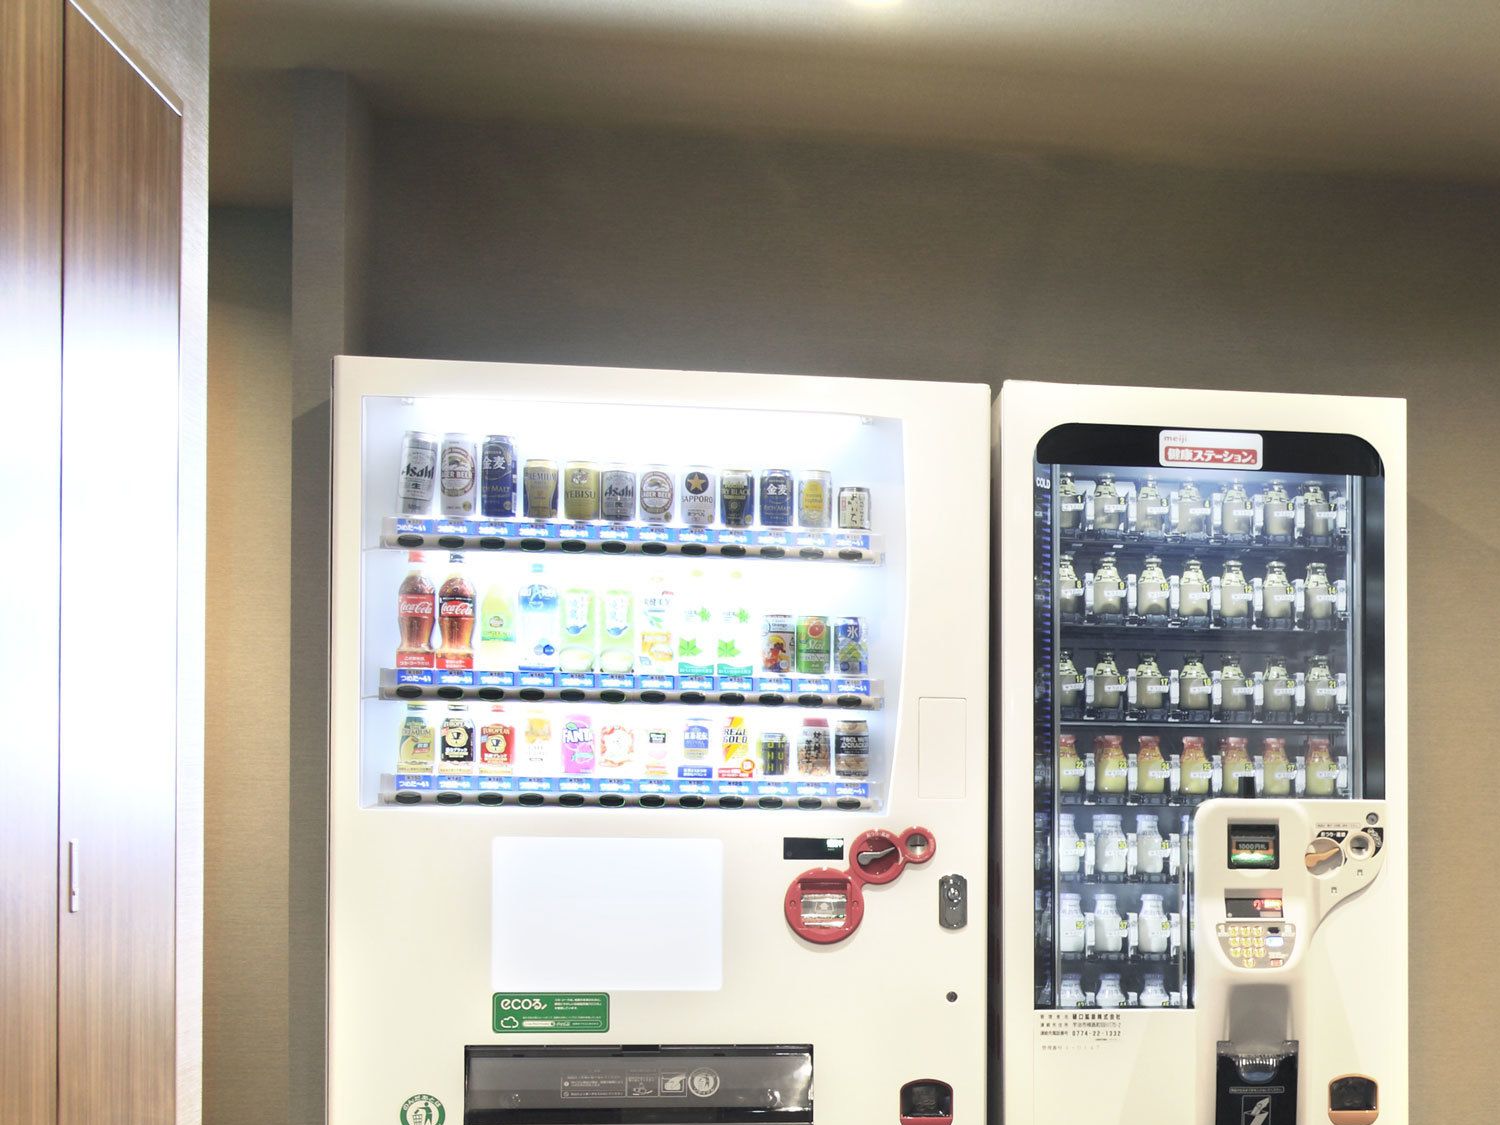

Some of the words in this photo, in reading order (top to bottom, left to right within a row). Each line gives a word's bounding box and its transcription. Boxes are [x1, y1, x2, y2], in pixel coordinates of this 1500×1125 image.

[1163, 434, 1188, 444] meiji
[1167, 447, 1253, 464] 健康ステーション
[482, 456, 507, 470] 金麦
[401, 463, 435, 480] Asahi
[766, 483, 788, 496] 金麦
[1035, 477, 1051, 489] COLD
[566, 490, 597, 499] YEBISU
[603, 485, 634, 498] Asahi
[681, 495, 713, 504] SAPPORO
[401, 601, 432, 615] Coca-Cola
[440, 601, 473, 616] Coca-Cola
[1075, 675, 1084, 683] 15
[1160, 678, 1169, 686] 17
